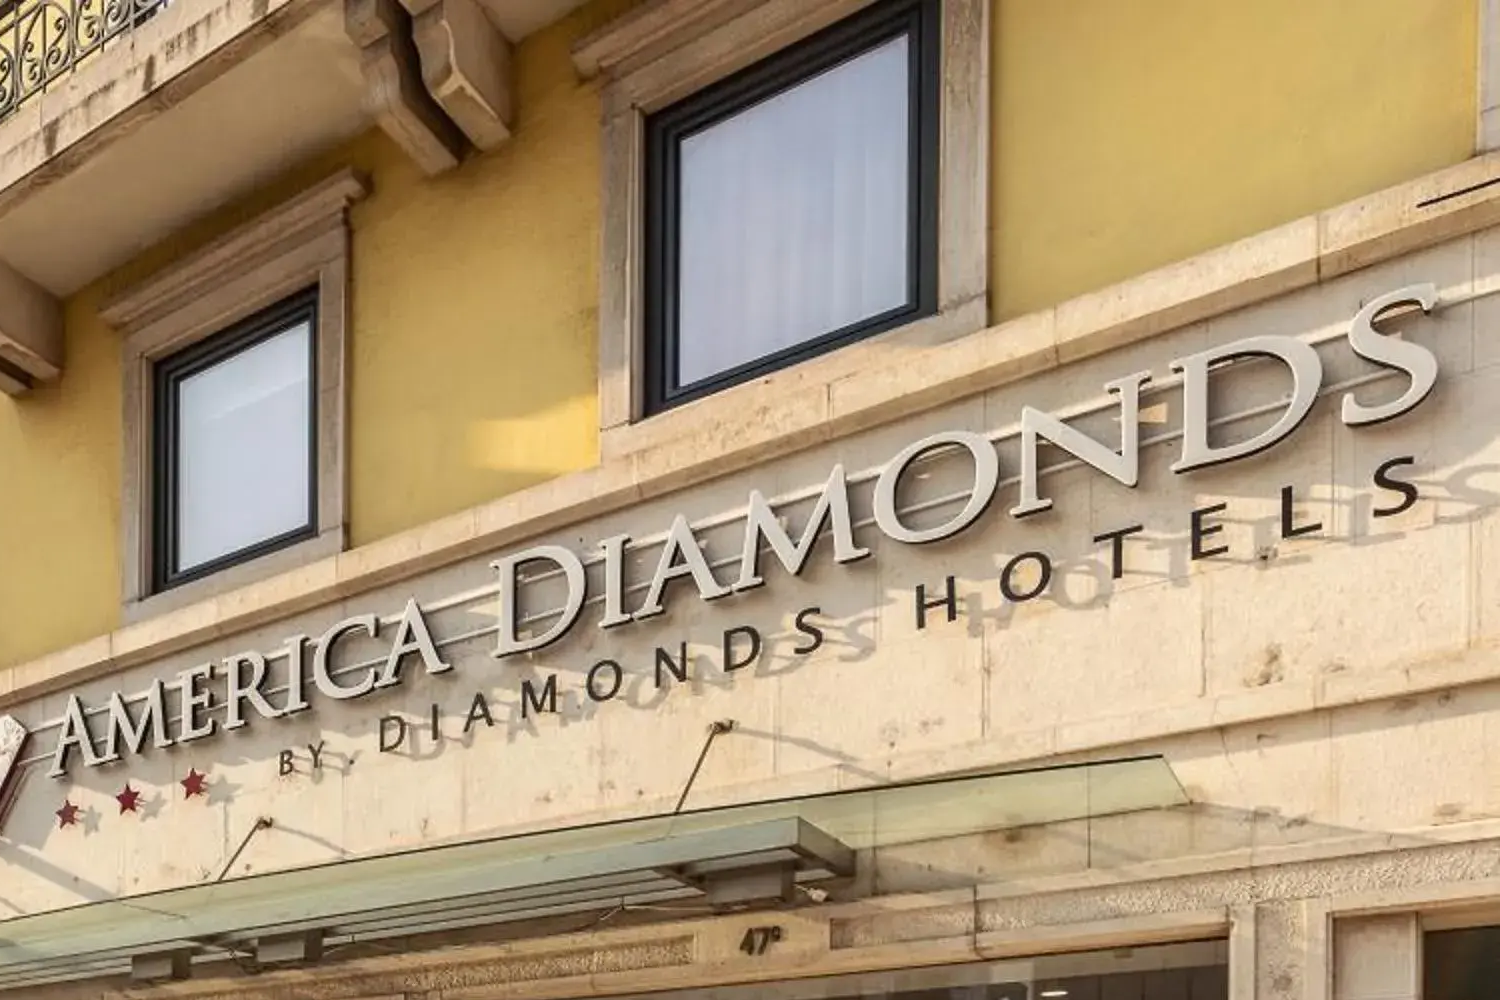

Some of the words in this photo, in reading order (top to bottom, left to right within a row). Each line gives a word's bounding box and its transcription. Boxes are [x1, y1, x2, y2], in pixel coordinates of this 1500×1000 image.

[46, 599, 453, 778] AMERICA
[489, 283, 1439, 659] DIAMONDS
[278, 739, 326, 777] BY
[379, 606, 824, 753] DIAMONDS
[915, 455, 1418, 630] HOTELS
